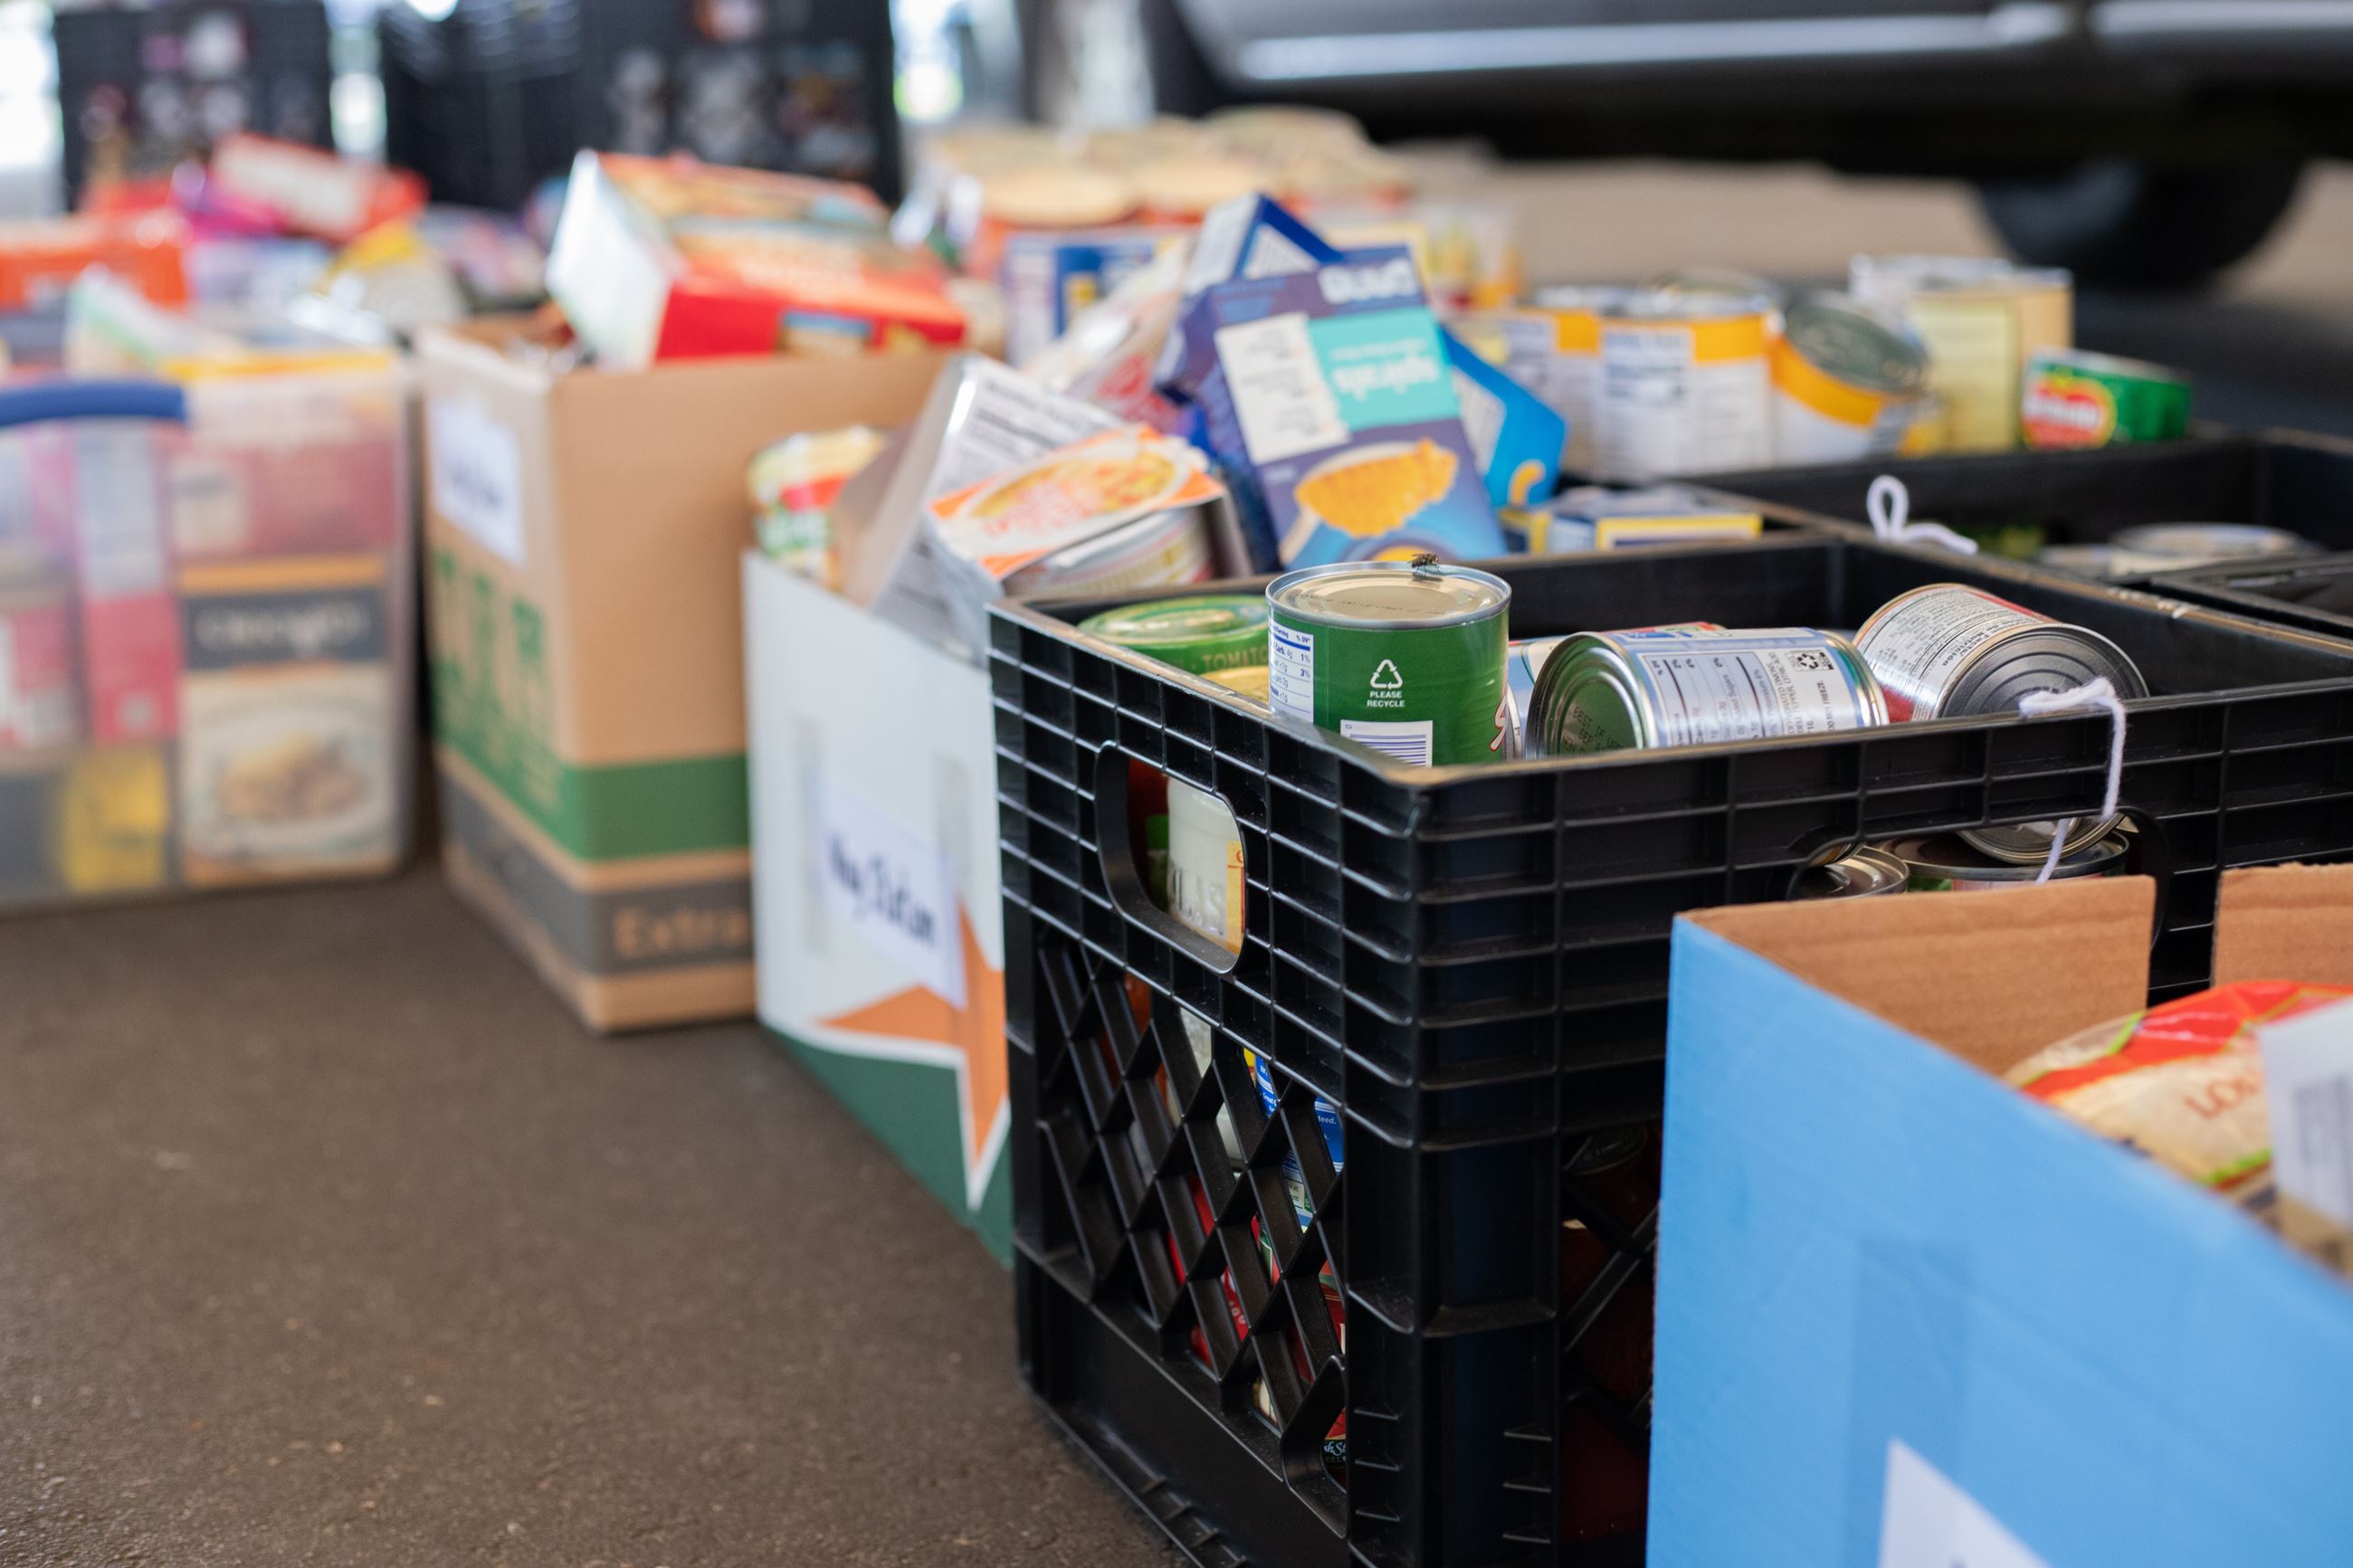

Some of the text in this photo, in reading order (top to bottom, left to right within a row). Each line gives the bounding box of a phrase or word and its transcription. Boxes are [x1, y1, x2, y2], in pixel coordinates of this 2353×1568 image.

[1300, 653, 1310, 663] 1%
[1369, 690, 1403, 698] PLEASE
[1367, 699, 1405, 708] RECYCLE
[1318, 1115, 1338, 1126] teed.
